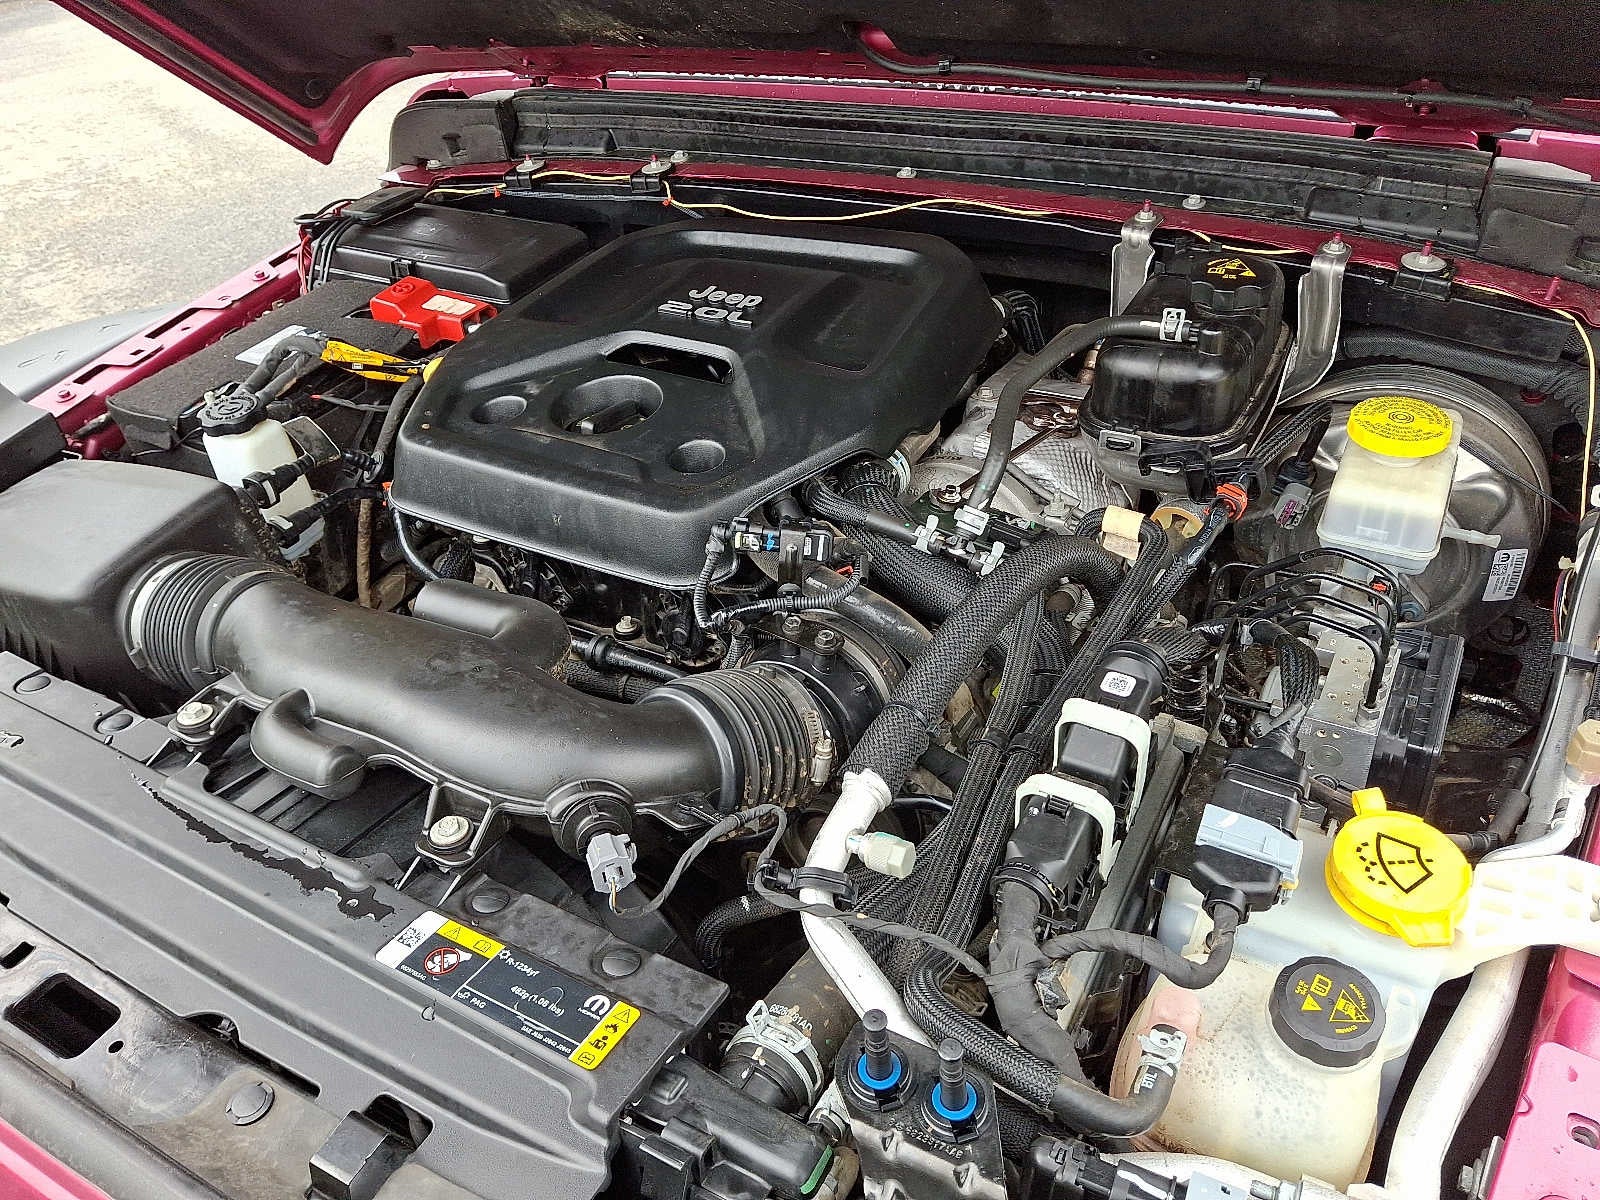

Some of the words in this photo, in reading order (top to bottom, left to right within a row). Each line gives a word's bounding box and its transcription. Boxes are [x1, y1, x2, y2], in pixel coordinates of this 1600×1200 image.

[688, 285, 763, 310] Jeep
[657, 300, 753, 328] 2.0L
[505, 957, 541, 977] R-1234yf
[470, 997, 486, 1009] PAG
